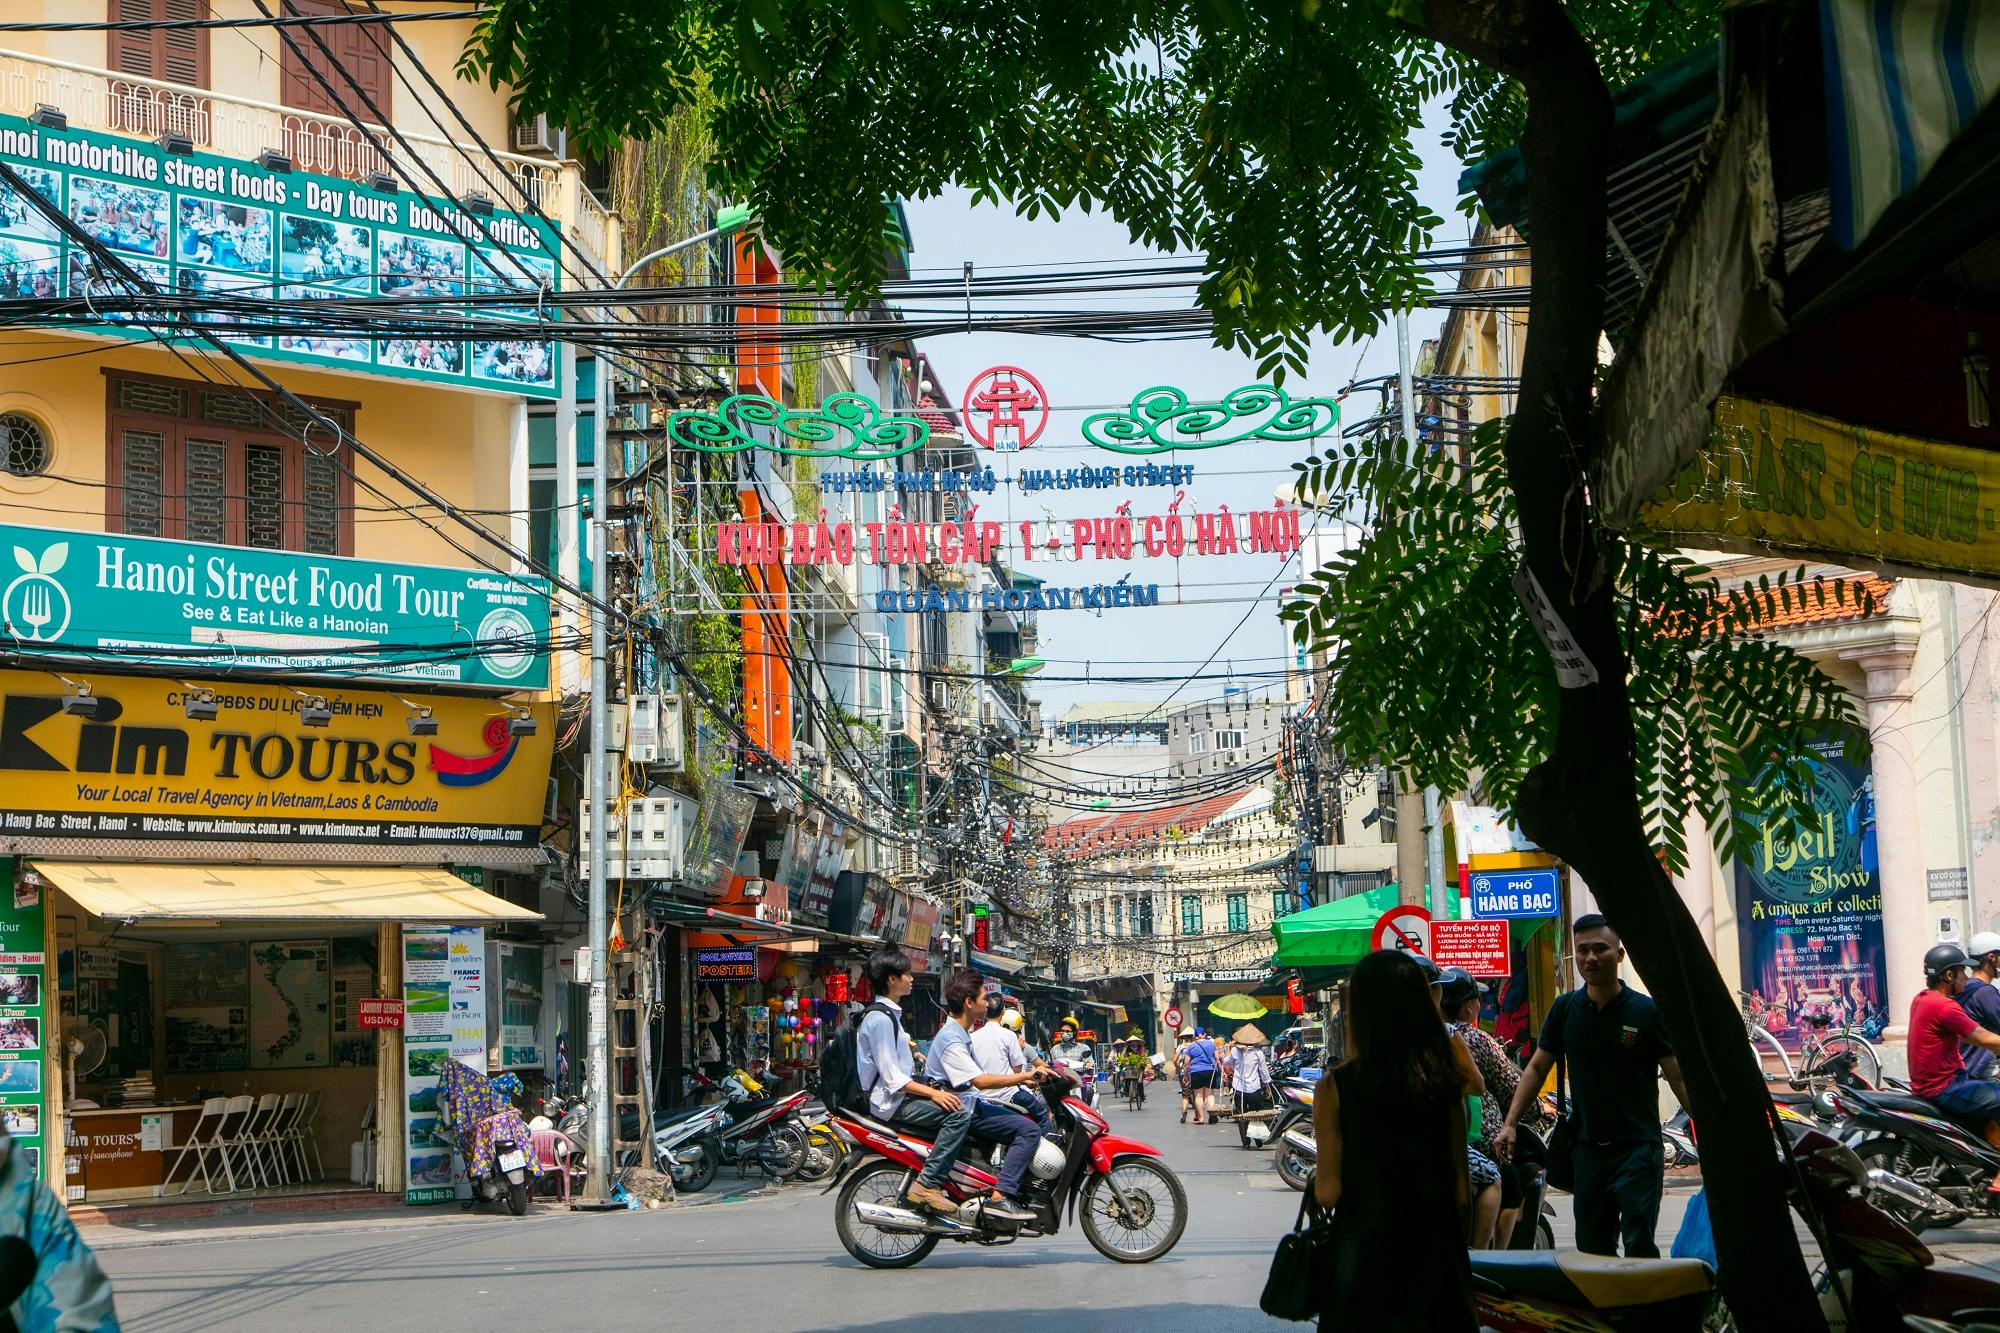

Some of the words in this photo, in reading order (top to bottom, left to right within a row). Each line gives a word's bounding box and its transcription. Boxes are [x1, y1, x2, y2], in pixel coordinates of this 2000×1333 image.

[0, 128, 39, 159] noi
[46, 134, 159, 182] motorbike
[164, 157, 225, 194] street
[230, 168, 287, 205] foods
[306, 181, 344, 218] Day
[349, 190, 398, 225] tours
[409, 201, 484, 244] booking
[489, 221, 541, 250] office
[1023, 466, 1116, 490] WALKING
[1123, 464, 1194, 487] STREET
[717, 522, 779, 565] KHU
[792, 507, 853, 565] BẢO
[940, 504, 1001, 564] CẤP
[1019, 520, 1032, 561] 1
[1074, 500, 1133, 560] PHỐ
[1145, 490, 1184, 558] CỔ
[1250, 498, 1300, 562] NỘI
[96, 545, 195, 596] Hanoi
[206, 556, 299, 606] Street
[308, 566, 383, 613] Food
[392, 574, 465, 618] Tour
[1083, 572, 1158, 608] KIẾM
[182, 602, 215, 621] See
[219, 605, 232, 622] &
[237, 607, 265, 625] Eat
[269, 610, 304, 629] Like
[308, 616, 318, 629] a
[323, 614, 389, 635] Hanoian
[415, 666, 455, 677] Vietnam
[259, 698, 278, 711] DU
[355, 703, 383, 719] HẸN
[0, 695, 189, 776] Kim
[210, 732, 416, 786] TOURS
[76, 784, 109, 802] Your
[112, 786, 153, 803] Local
[157, 786, 200, 805] Travel
[200, 789, 253, 810] Agency
[256, 791, 268, 807] in
[361, 796, 371, 809] &
[375, 795, 439, 812] Cambodia
[5, 813, 32, 830] Hang
[35, 814, 56, 829] Bac
[98, 815, 128, 831] Hanoi
[142, 817, 185, 832] Website:
[187, 819, 290, 835] www.kimtours.com.vn
[299, 822, 380, 838] www.kimtours.net
[390, 824, 418, 839] Email:
[418, 825, 523, 842] kimtours137@gmail.com
[1508, 878, 1533, 890] PHỐ
[1809, 864, 1869, 894] Show
[1478, 892, 1519, 911] HÀNG
[1522, 893, 1552, 912] BẠC
[1752, 900, 1765, 920] A
[1768, 901, 1808, 919] unique
[1813, 898, 1832, 913] art
[975, 908, 987, 916] SPA
[1795, 917, 1810, 925] 8pm
[1811, 917, 1830, 925] every
[1832, 914, 1863, 923] Saturday
[1439, 923, 1463, 932] TUYẾN
[1464, 923, 1479, 932] PHỐ
[1489, 924, 1500, 932] BỘ
[1819, 925, 1837, 933] Hang
[22, 954, 41, 963] Hanoi
[700, 965, 753, 976] POSTER
[1173, 972, 1205, 981] PEPPER
[1212, 970, 1242, 981] GREEN
[1244, 968, 1273, 979] PEPPE
[361, 1002, 382, 1013] LAUNDRY
[383, 1003, 403, 1014] SERVICE
[364, 1016, 399, 1026] USD/Kg
[455, 1025, 483, 1040] THAI
[94, 1134, 133, 1146] TOURS
[409, 1192, 417, 1200] 74
[417, 1191, 432, 1200] Hang
[433, 1190, 444, 1199] Bac
[445, 1189, 454, 1199] Str
